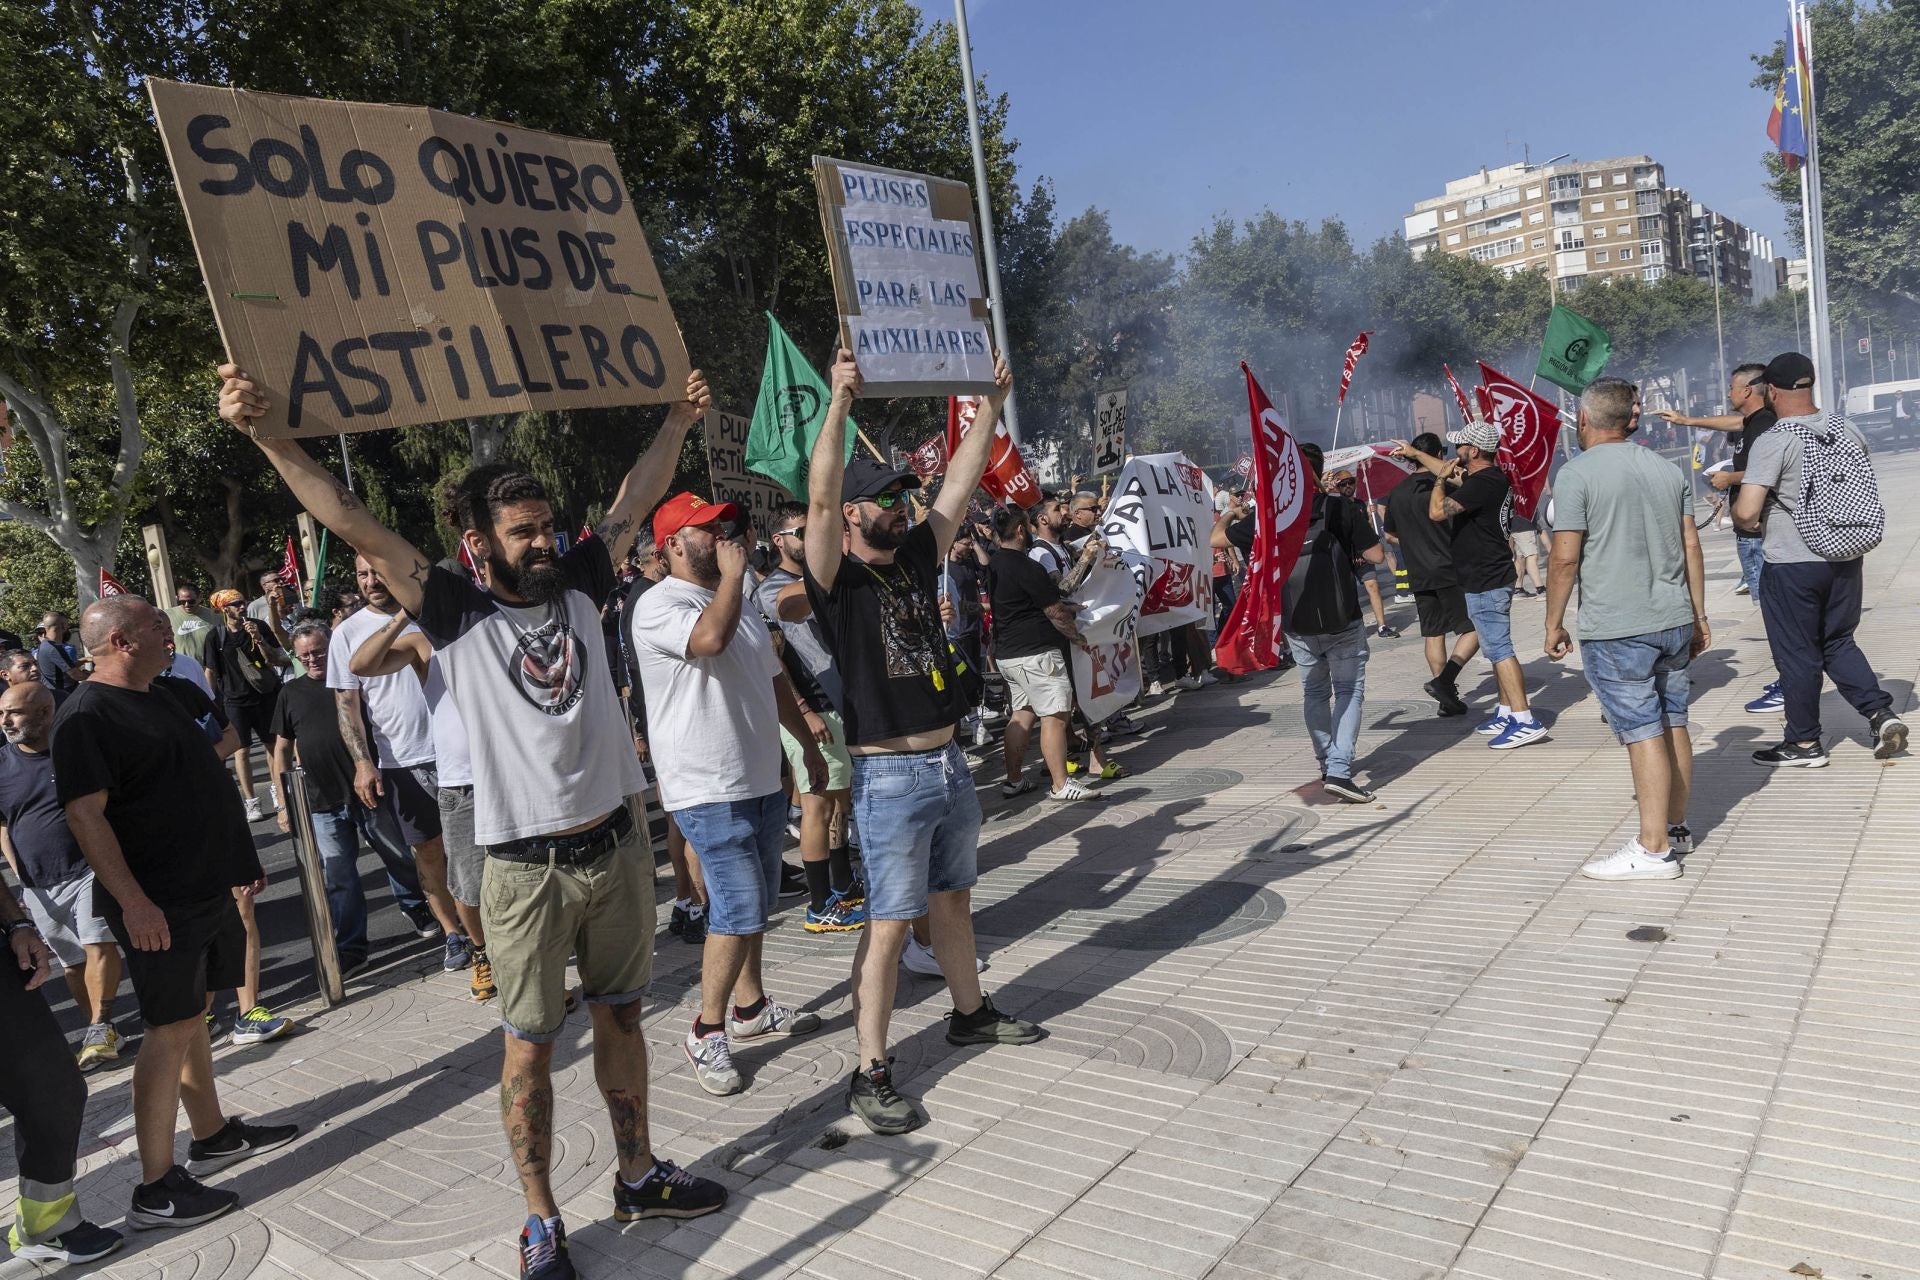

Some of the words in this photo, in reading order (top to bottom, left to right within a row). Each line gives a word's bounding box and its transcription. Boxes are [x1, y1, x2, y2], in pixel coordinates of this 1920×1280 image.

[186, 114, 396, 205] SOLO
[842, 173, 929, 208] PLUSES
[845, 220, 974, 258] ESPECIALES
[416, 219, 552, 291] PLUS
[557, 230, 631, 294] DE
[857, 279, 922, 307] PARA
[930, 281, 967, 308] LAS
[856, 327, 985, 356] AUXILIARES
[721, 415, 749, 445] PLU
[1100, 409, 1112, 426] SOY
[1149, 464, 1182, 496] LA
